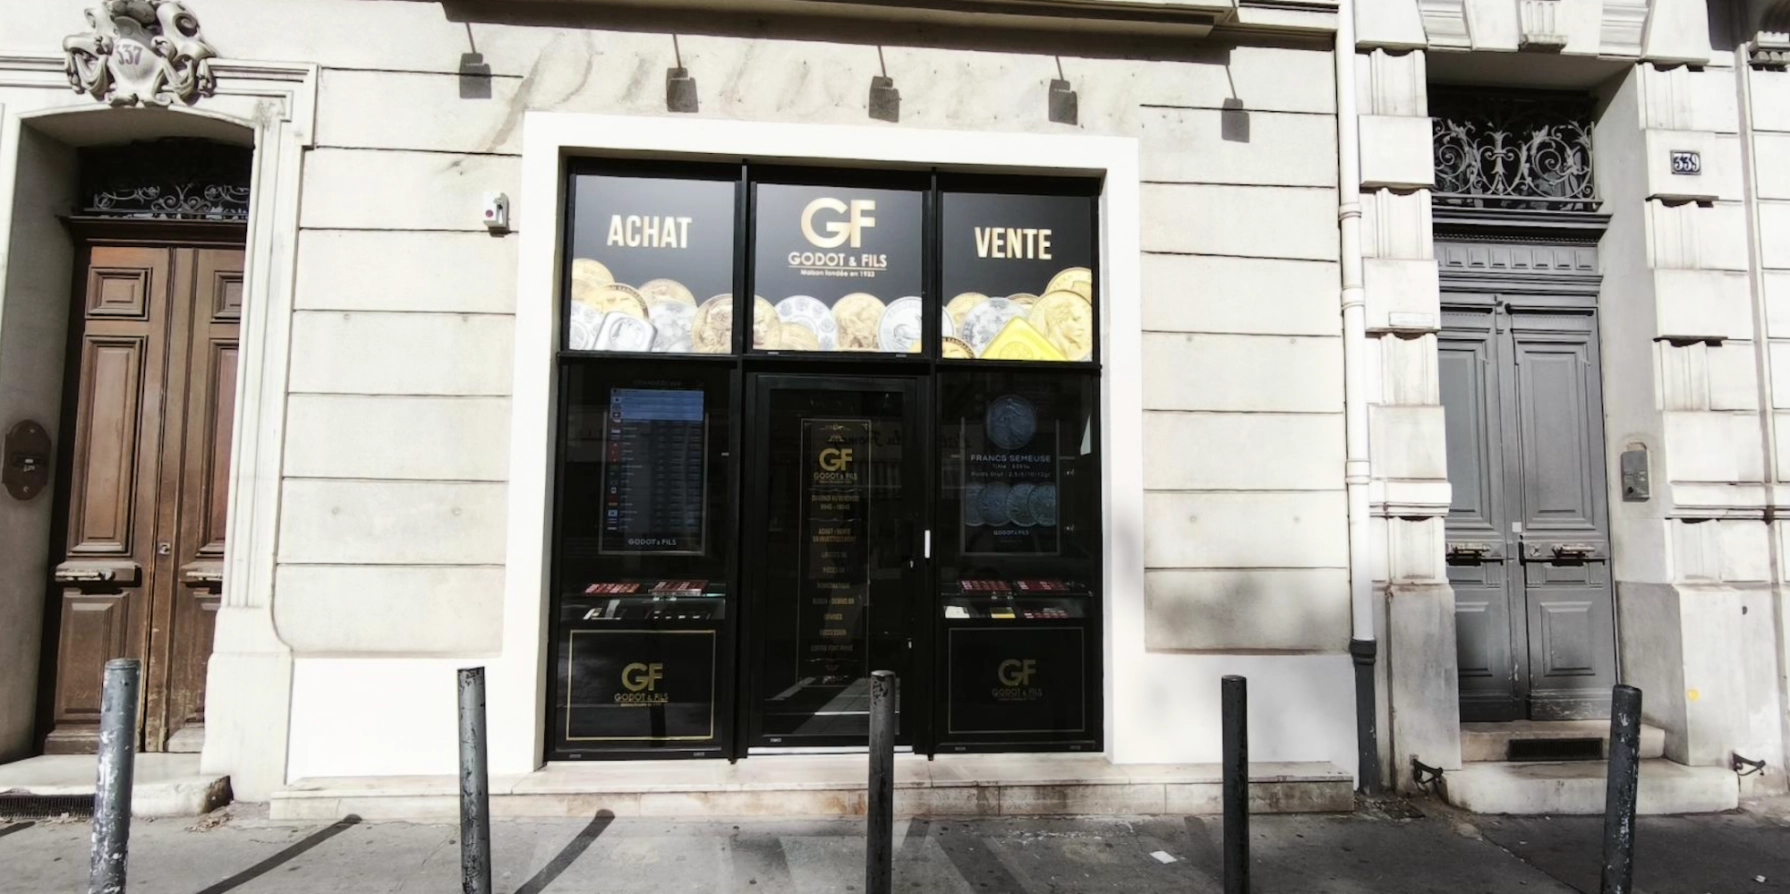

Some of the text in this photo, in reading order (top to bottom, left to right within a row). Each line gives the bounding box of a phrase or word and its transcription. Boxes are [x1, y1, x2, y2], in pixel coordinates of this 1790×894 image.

[1673, 152, 1700, 173] 339
[607, 214, 692, 249] ACHAT
[800, 197, 876, 249] GF
[974, 227, 1052, 260] VENTE
[788, 251, 888, 268] GODOT & FILS
[800, 269, 824, 277] Maison
[818, 447, 853, 471] GF
[970, 454, 1051, 463] FRANCS SEMEUSE
[627, 538, 655, 546] GODOT
[661, 538, 677, 546] FILS
[621, 662, 663, 692] GF
[997, 658, 1037, 686] GF
[614, 693, 646, 702] GODOT
[654, 693, 669, 702] FILS
